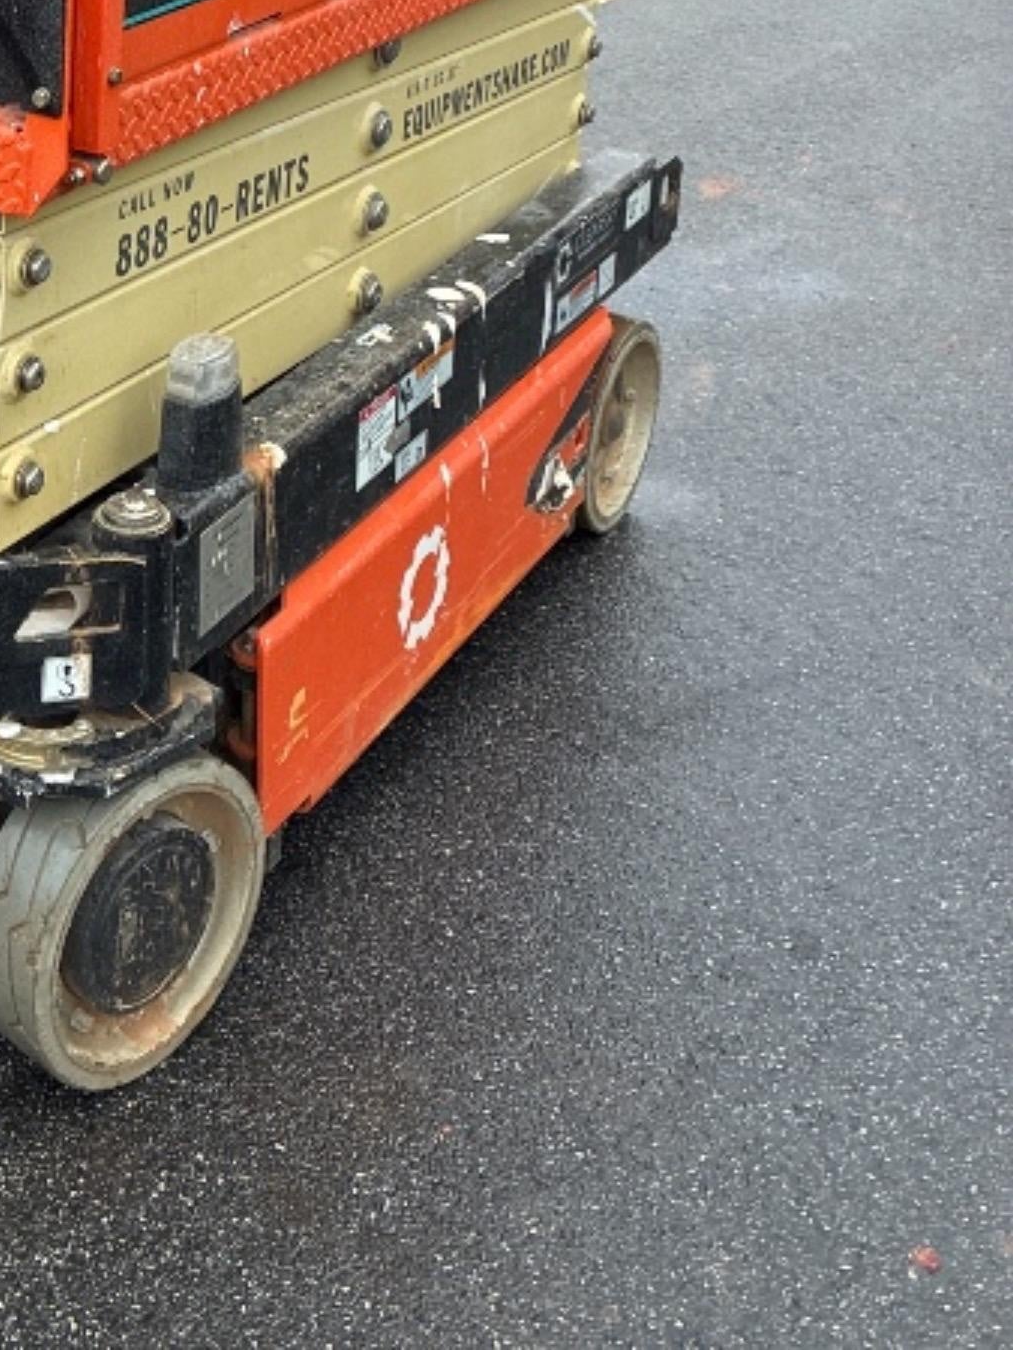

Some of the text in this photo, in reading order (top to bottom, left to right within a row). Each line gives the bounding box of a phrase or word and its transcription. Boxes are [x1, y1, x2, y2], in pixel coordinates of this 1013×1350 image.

[115, 154, 310, 278] 888-80-RENTS
[118, 170, 196, 220] CALL NOW
